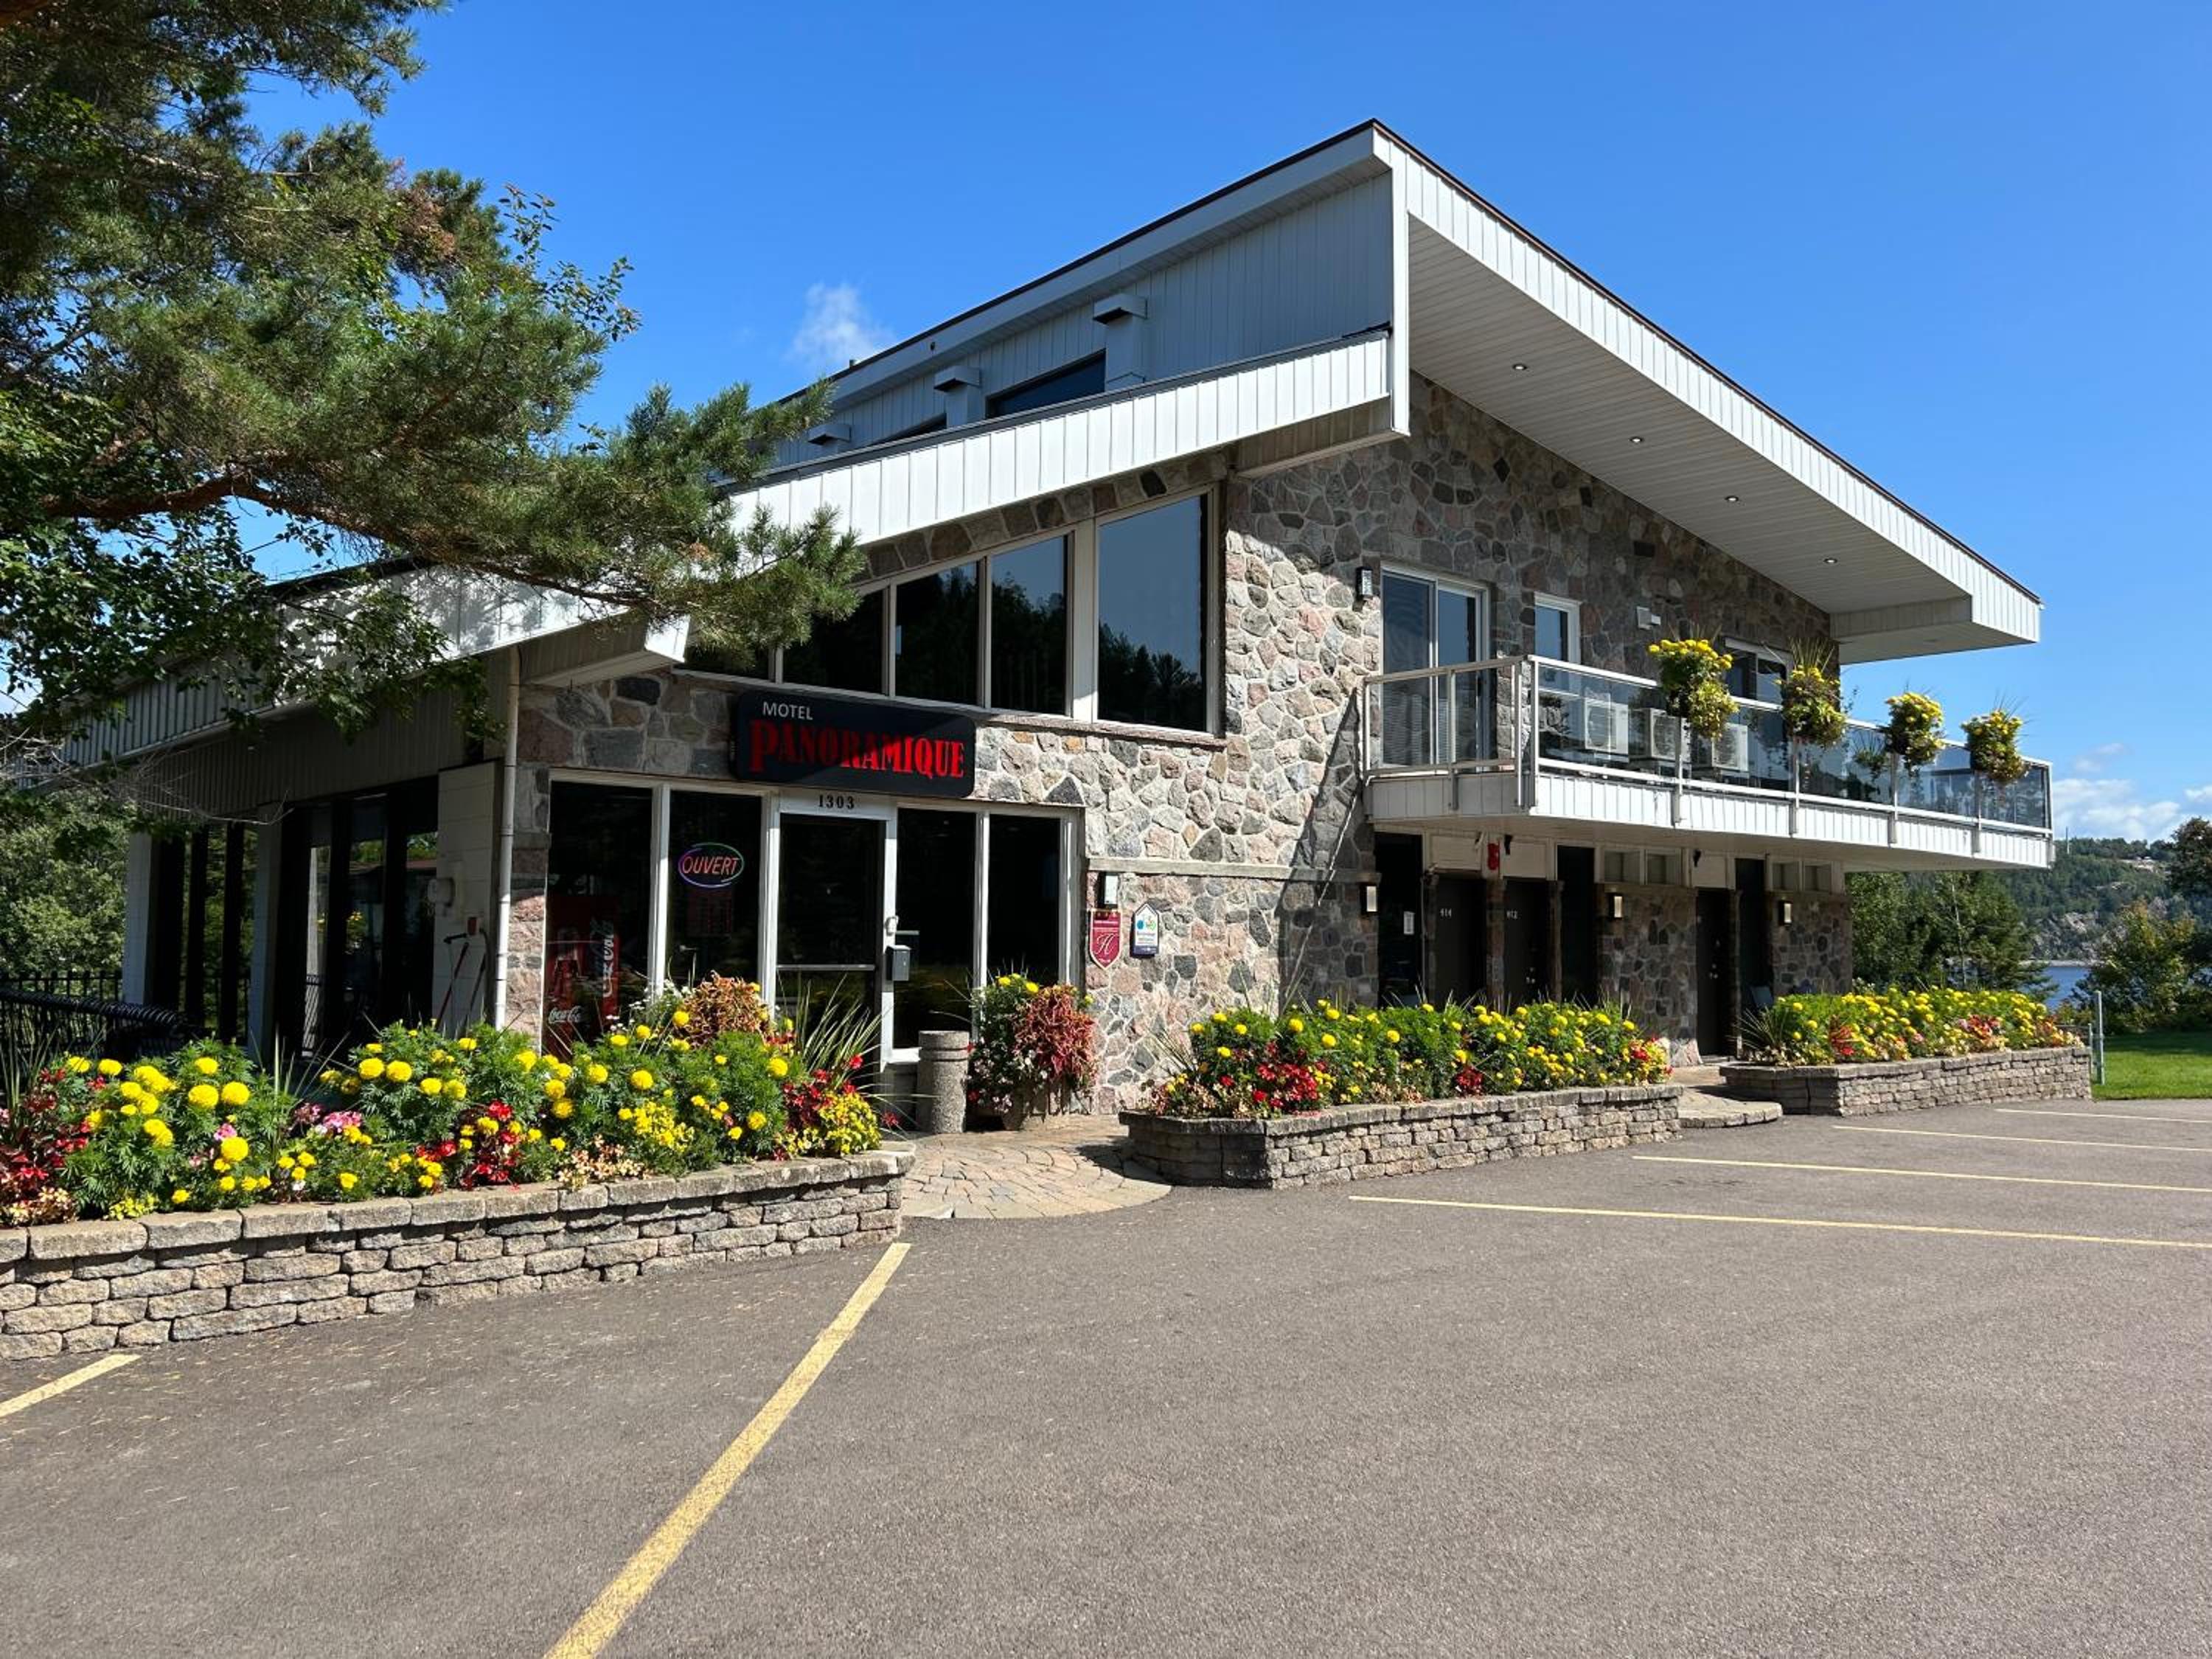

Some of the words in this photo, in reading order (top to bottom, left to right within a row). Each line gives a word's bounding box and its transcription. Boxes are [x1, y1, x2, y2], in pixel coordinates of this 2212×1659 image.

[762, 701, 813, 720] MOTEL
[748, 719, 965, 779] PANORAMIQUE
[818, 794, 855, 810] 1303
[682, 855, 740, 875] OUVERT
